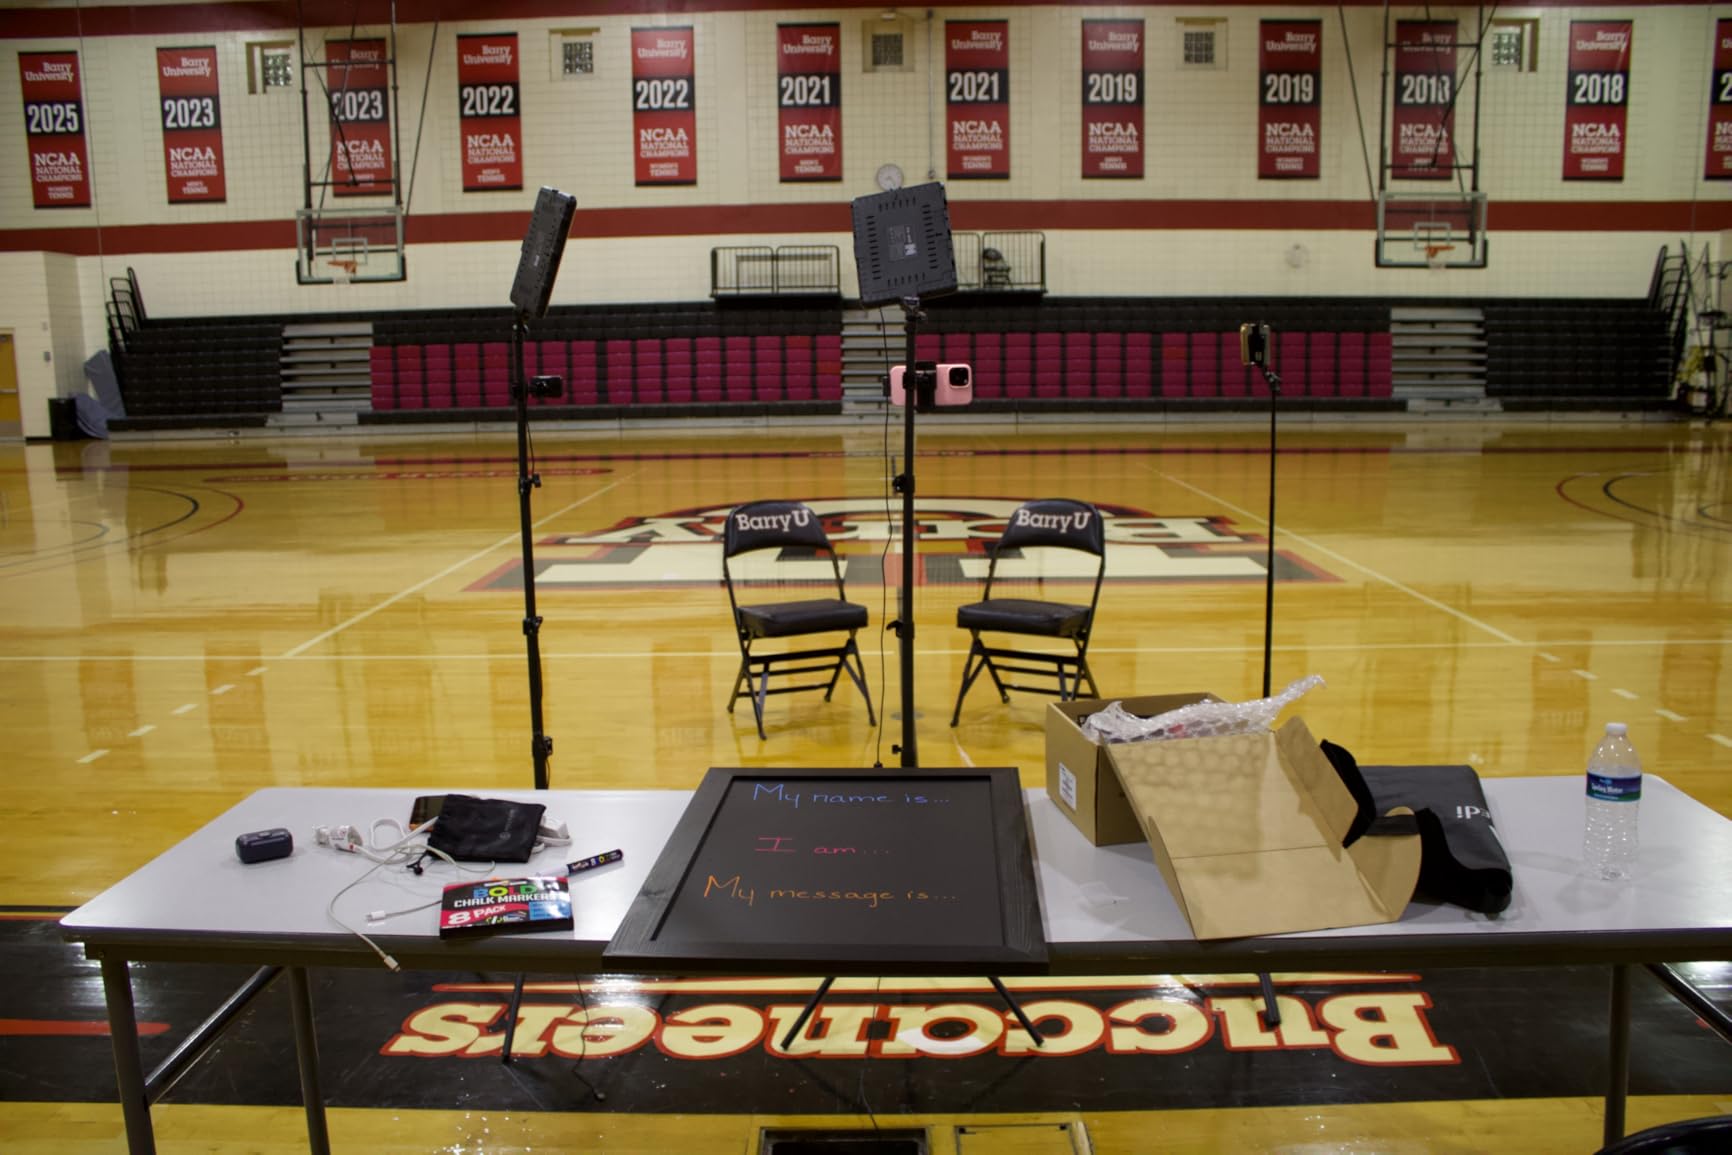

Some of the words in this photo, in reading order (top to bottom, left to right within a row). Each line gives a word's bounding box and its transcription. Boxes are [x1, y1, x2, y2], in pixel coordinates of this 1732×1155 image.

[802, 35, 832, 46] Barry
[971, 31, 1002, 41] Barry
[1109, 32, 1139, 42] Barry
[1285, 32, 1316, 42] Barry
[1596, 31, 1627, 42] Barry
[656, 39, 687, 50] Barry
[783, 44, 834, 56] University
[952, 39, 1003, 51] University
[1088, 40, 1140, 52] University
[1265, 40, 1317, 52] University
[1575, 40, 1627, 53] University
[350, 50, 379, 62] Barry
[482, 45, 512, 57] Barry
[637, 48, 688, 59] University
[181, 57, 211, 68] Barry
[463, 54, 513, 65] University
[42, 61, 74, 73] Barry
[163, 66, 211, 77] University
[25, 71, 74, 82] University
[781, 75, 831, 106] 2021
[949, 72, 1001, 102] 2021
[1088, 73, 1138, 103] 2019
[1265, 73, 1315, 103] 2019
[1573, 73, 1624, 103] 2018
[636, 79, 689, 109] 2022
[332, 90, 384, 120] 2023
[462, 85, 515, 116] 2022
[28, 103, 81, 133] 2025
[164, 98, 216, 128] 2023
[785, 124, 833, 138] NCAA
[953, 120, 1002, 134] NCAA
[1088, 122, 1138, 136] NCAA
[1264, 122, 1314, 136] NCAA
[1400, 122, 1449, 137] NCAA
[1571, 123, 1620, 137] NCAA
[467, 134, 515, 148] NCAA
[640, 128, 688, 142] NCAA
[953, 134, 1002, 142] NATIONAL
[1088, 135, 1138, 144] NATIONAL
[1264, 136, 1314, 144] NATIONAL
[1571, 136, 1620, 145] NATIONAL
[337, 140, 384, 154] NCAA
[640, 141, 689, 150] NATIONAL
[785, 137, 833, 146] NATIONAL
[953, 141, 1003, 150] CHAMPIONS
[170, 146, 217, 161] NCAA
[468, 148, 515, 156] NATIONAL
[640, 149, 690, 158] CHAMPIONS
[785, 145, 835, 154] CHAMPIONS
[1088, 144, 1140, 152] CHAMPIONS
[1264, 144, 1316, 153] CHAMPIONS
[1570, 144, 1620, 153] CHAMPIONS
[34, 151, 81, 166] NCAA
[468, 156, 516, 164] CHAMPIONS
[36, 164, 82, 174] NATIONAL
[170, 160, 217, 170] NATIONAL
[36, 173, 83, 182] CHAMPIONS
[171, 169, 219, 177] CHAMPIONS
[753, 783, 800, 808] My
[812, 793, 888, 804] name
[754, 836, 797, 852] I
[703, 874, 754, 907] My
[770, 888, 894, 908] message
[454, 893, 496, 908] CHALK
[448, 910, 472, 926] 8
[473, 904, 508, 919] PACK
[379, 992, 1462, 1067] Buccaneers
